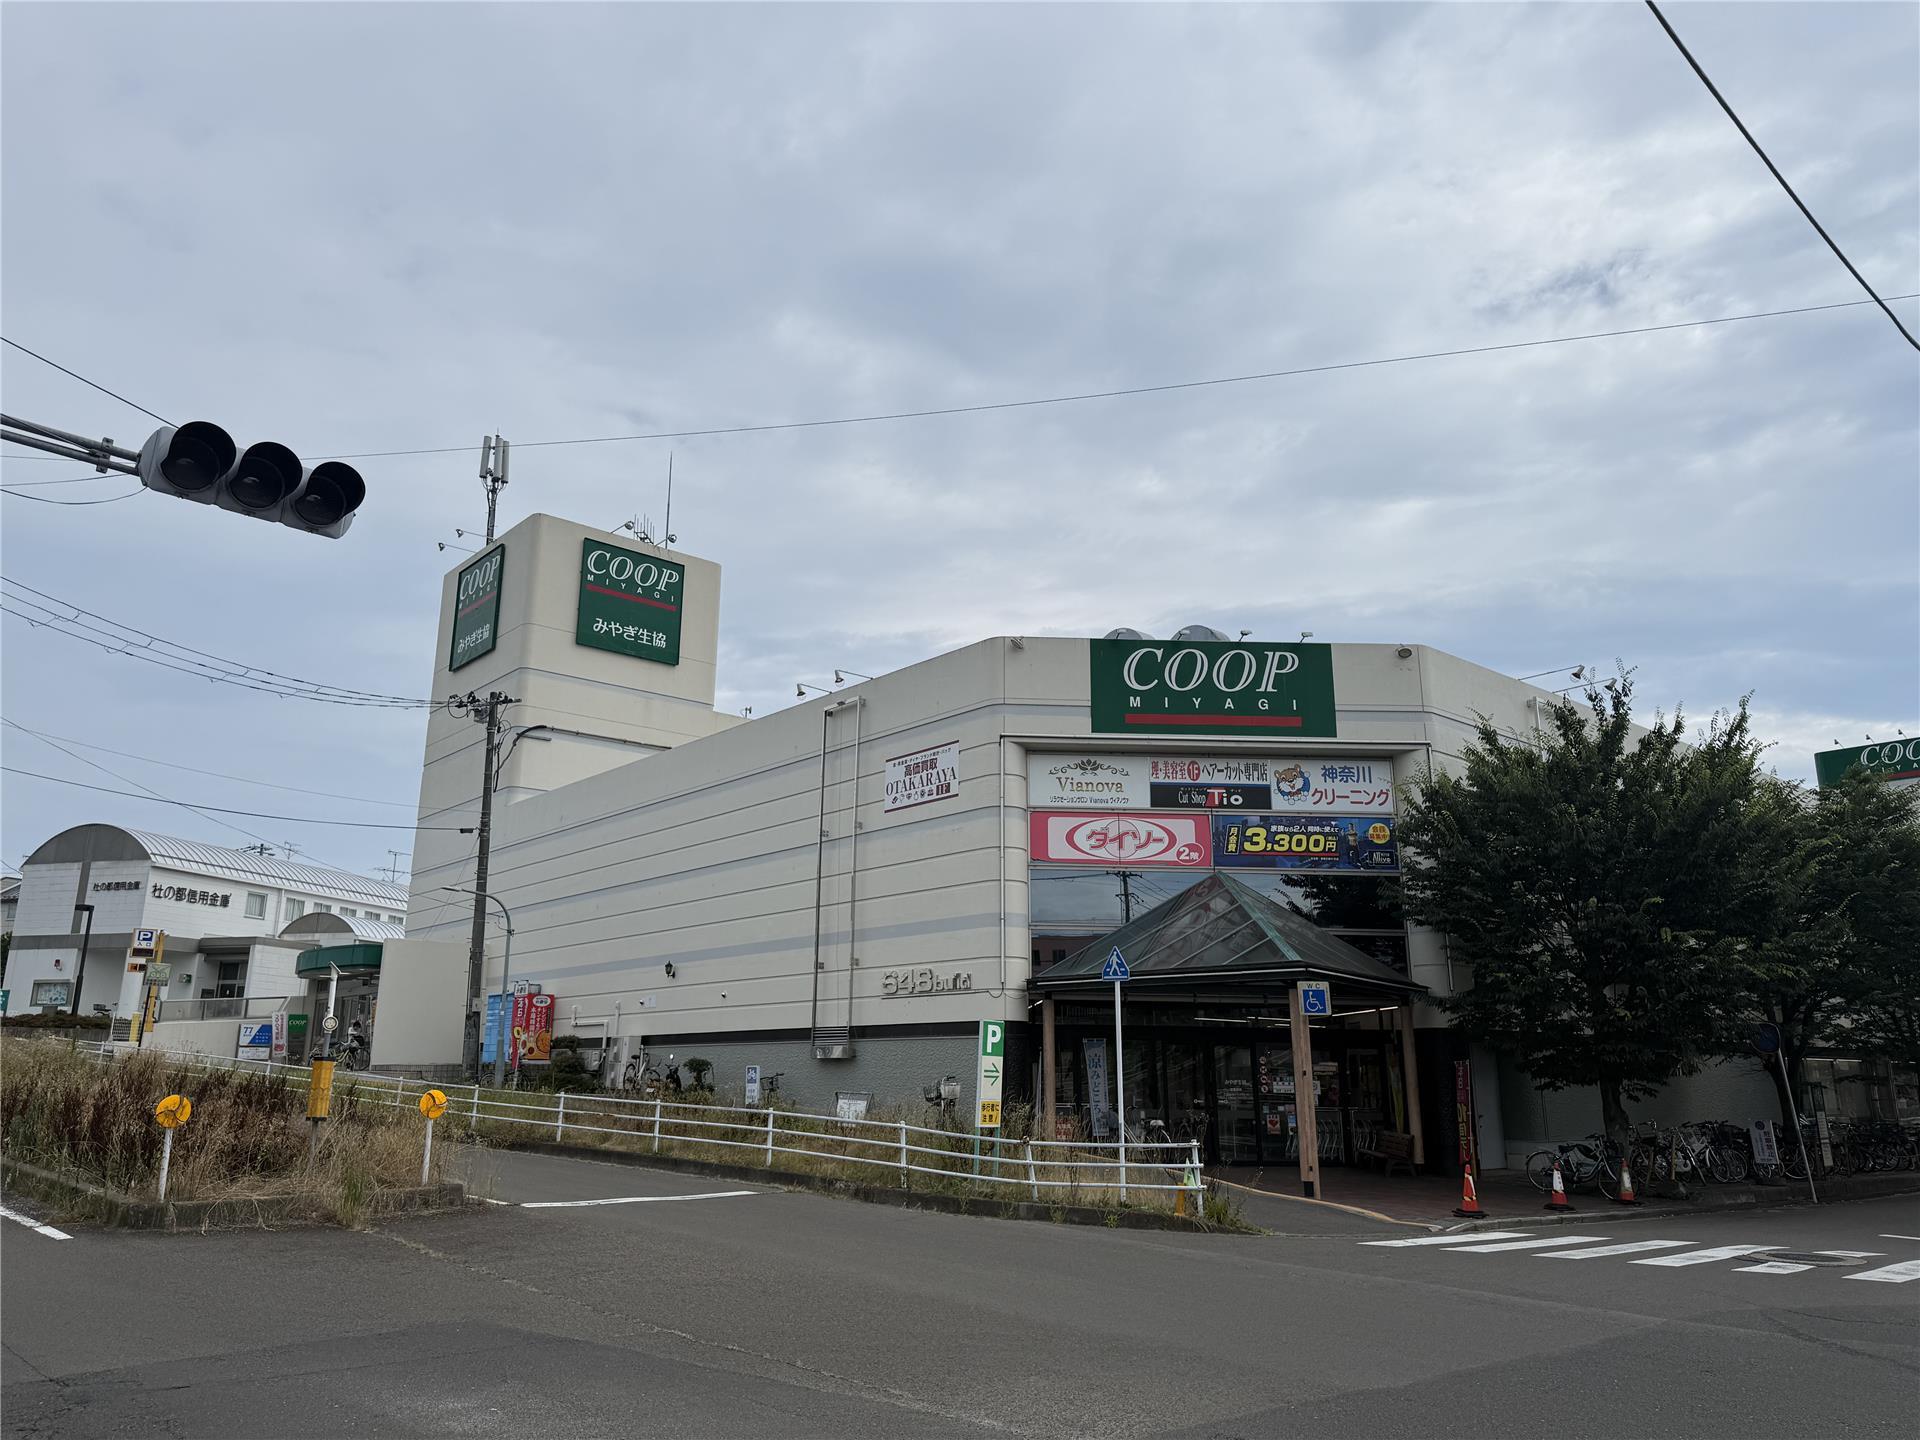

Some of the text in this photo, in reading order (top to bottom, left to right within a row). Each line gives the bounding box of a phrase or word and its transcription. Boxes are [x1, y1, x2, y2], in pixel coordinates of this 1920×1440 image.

[460, 555, 500, 600] COOP
[588, 550, 680, 591] COOP
[587, 574, 674, 602] MIYAGI
[458, 624, 490, 653] みやぎ生協
[593, 618, 667, 649] みやぎ生協
[1123, 648, 1300, 692] COOP
[1129, 696, 1298, 711] MIYAGI
[904, 757, 937, 778] 高価買取
[1189, 763, 1199, 779] 1F
[1201, 762, 1268, 781] ヘアーカット専門店
[1321, 764, 1373, 783] 神奈川
[886, 766, 957, 796] OTAKARAYA
[1056, 776, 1124, 793] Vianova
[1178, 789, 1243, 807] Cut Shop Tio
[1311, 788, 1391, 806] クリーニング
[1086, 827, 1164, 850] ダイソー
[1243, 826, 1337, 852] 3,300円
[1178, 846, 1200, 860] 2階
[93, 881, 141, 892] 杜の都信用金庫
[151, 882, 232, 908] 杜の都信用金庫
[140, 931, 152, 941] P
[243, 1026, 254, 1034] 77
[986, 1024, 1001, 1053] P
[981, 1103, 1000, 1112] 歩行者に
